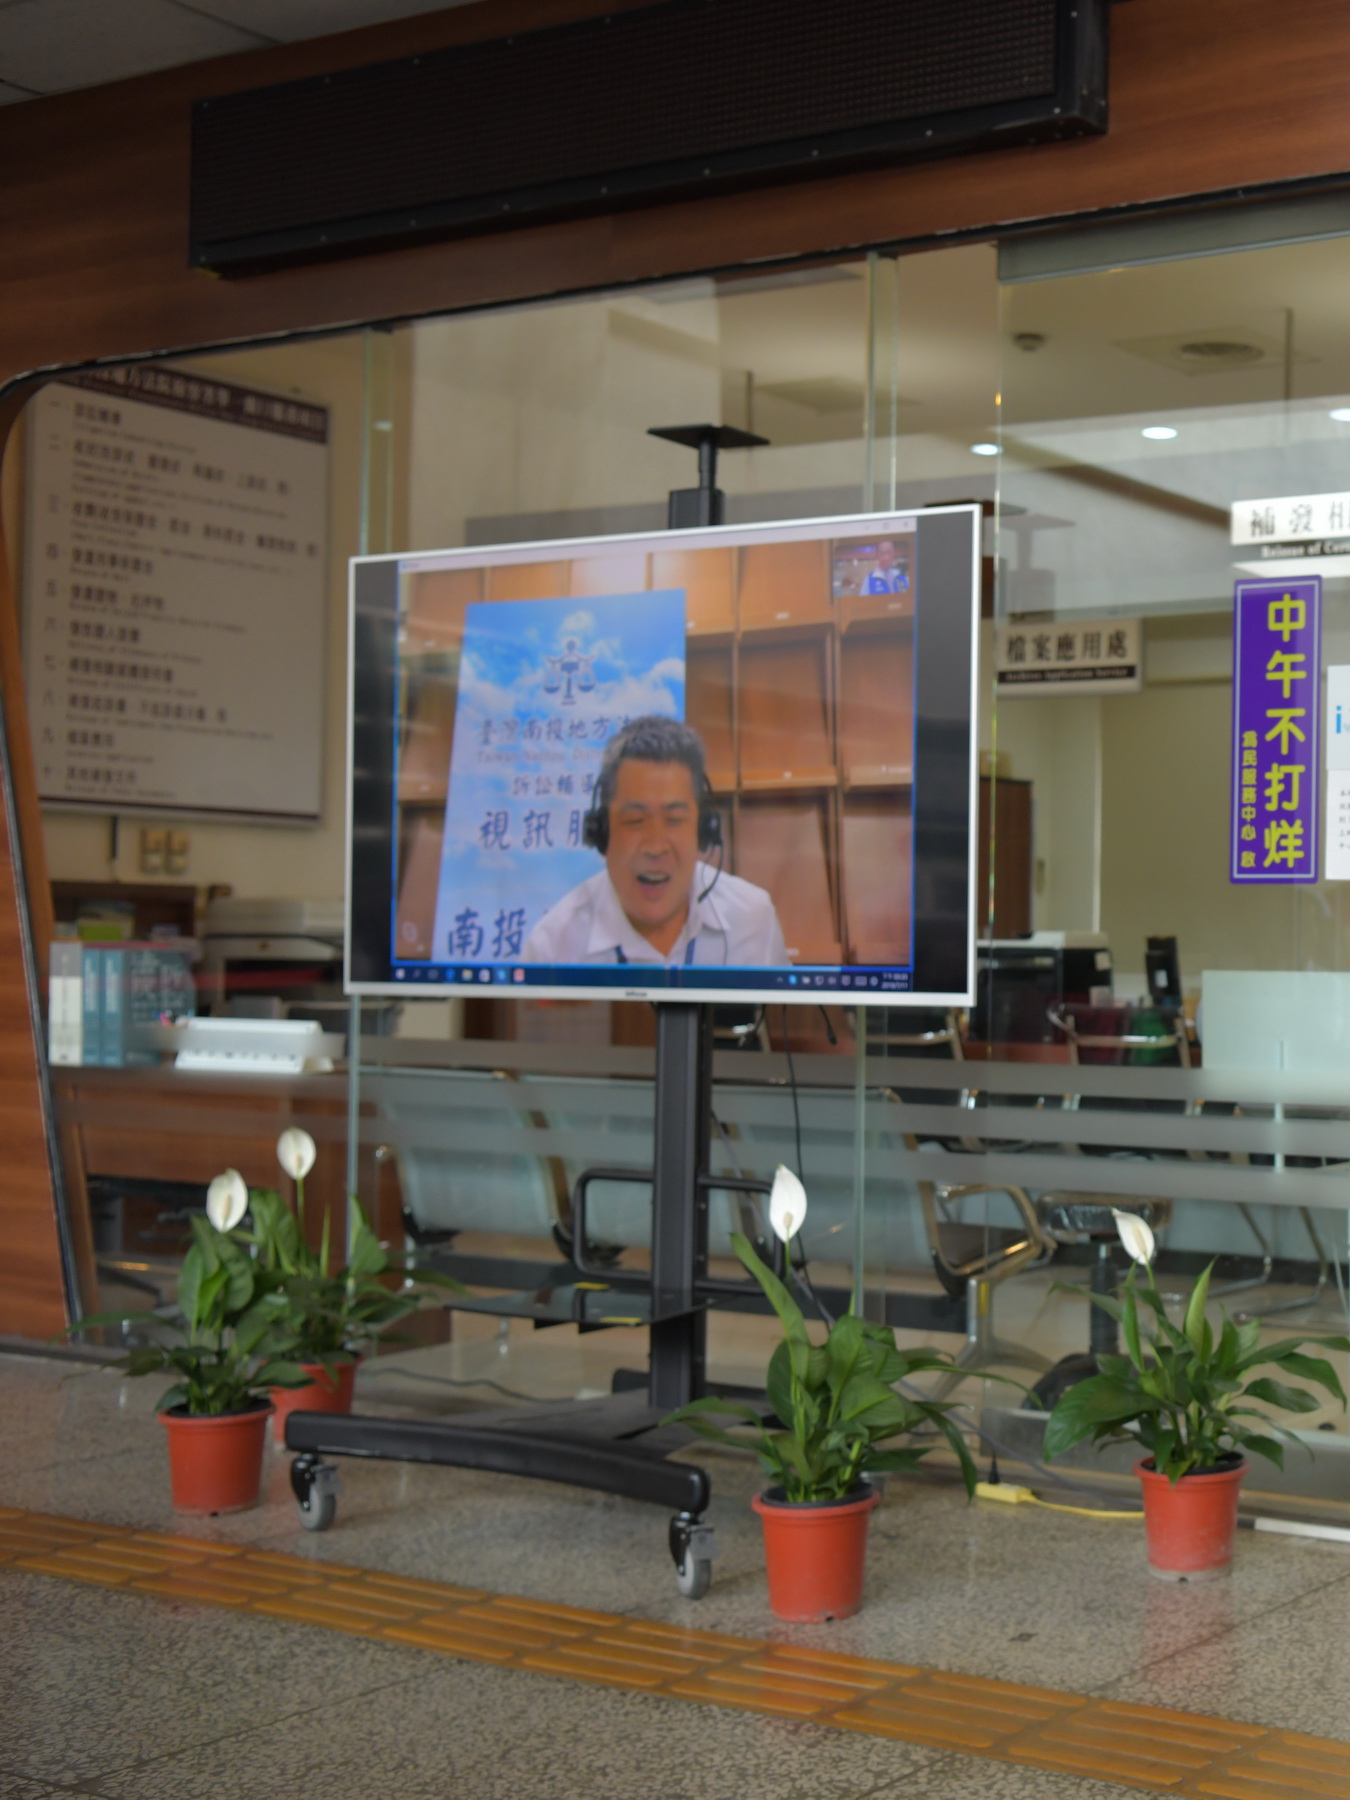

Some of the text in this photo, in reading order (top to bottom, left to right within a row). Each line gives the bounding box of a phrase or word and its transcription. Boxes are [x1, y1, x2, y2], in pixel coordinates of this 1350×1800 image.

[1262, 593, 1307, 868] 中午不打烊
